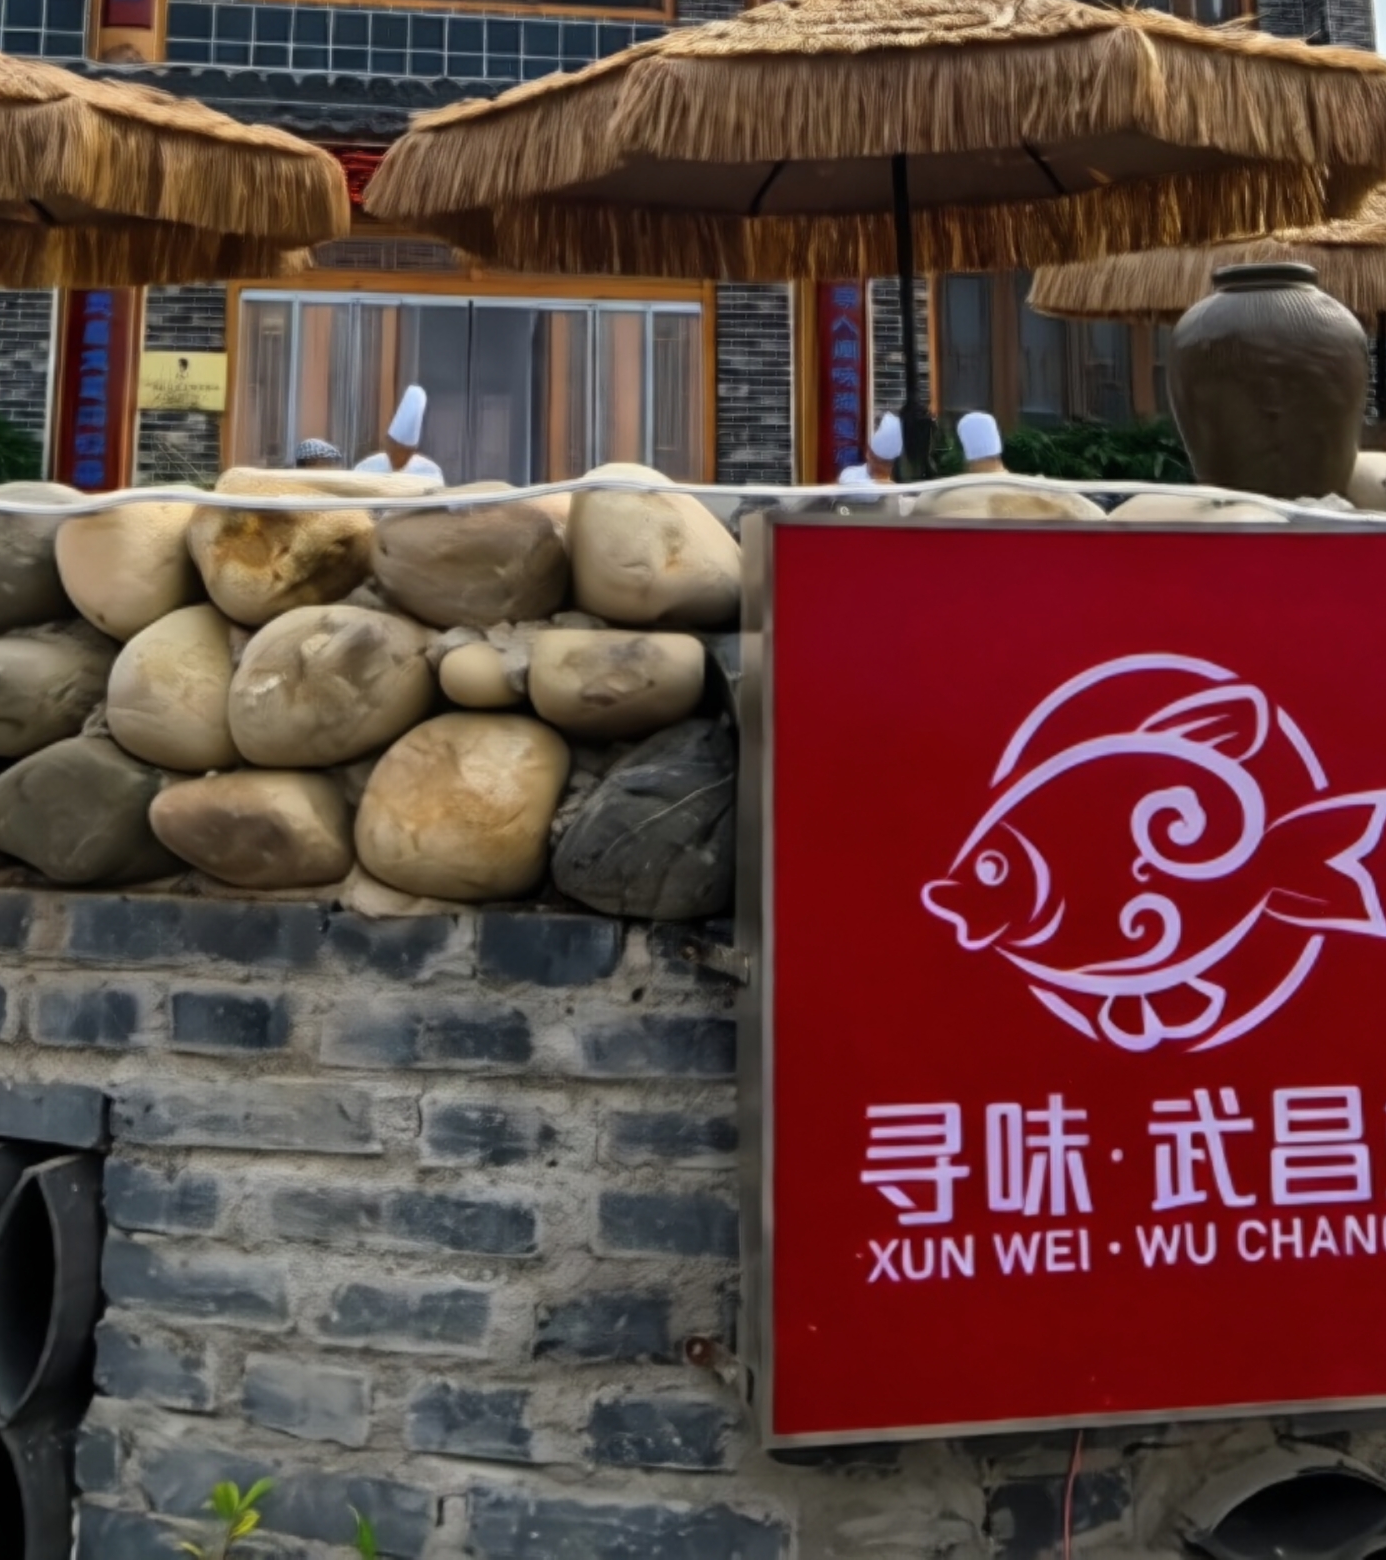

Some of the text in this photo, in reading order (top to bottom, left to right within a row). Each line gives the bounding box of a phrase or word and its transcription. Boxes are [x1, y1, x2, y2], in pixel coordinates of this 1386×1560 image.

[868, 1235, 974, 1282] XUN
[993, 1228, 1091, 1275] WEI
[1136, 1222, 1217, 1268] WU
